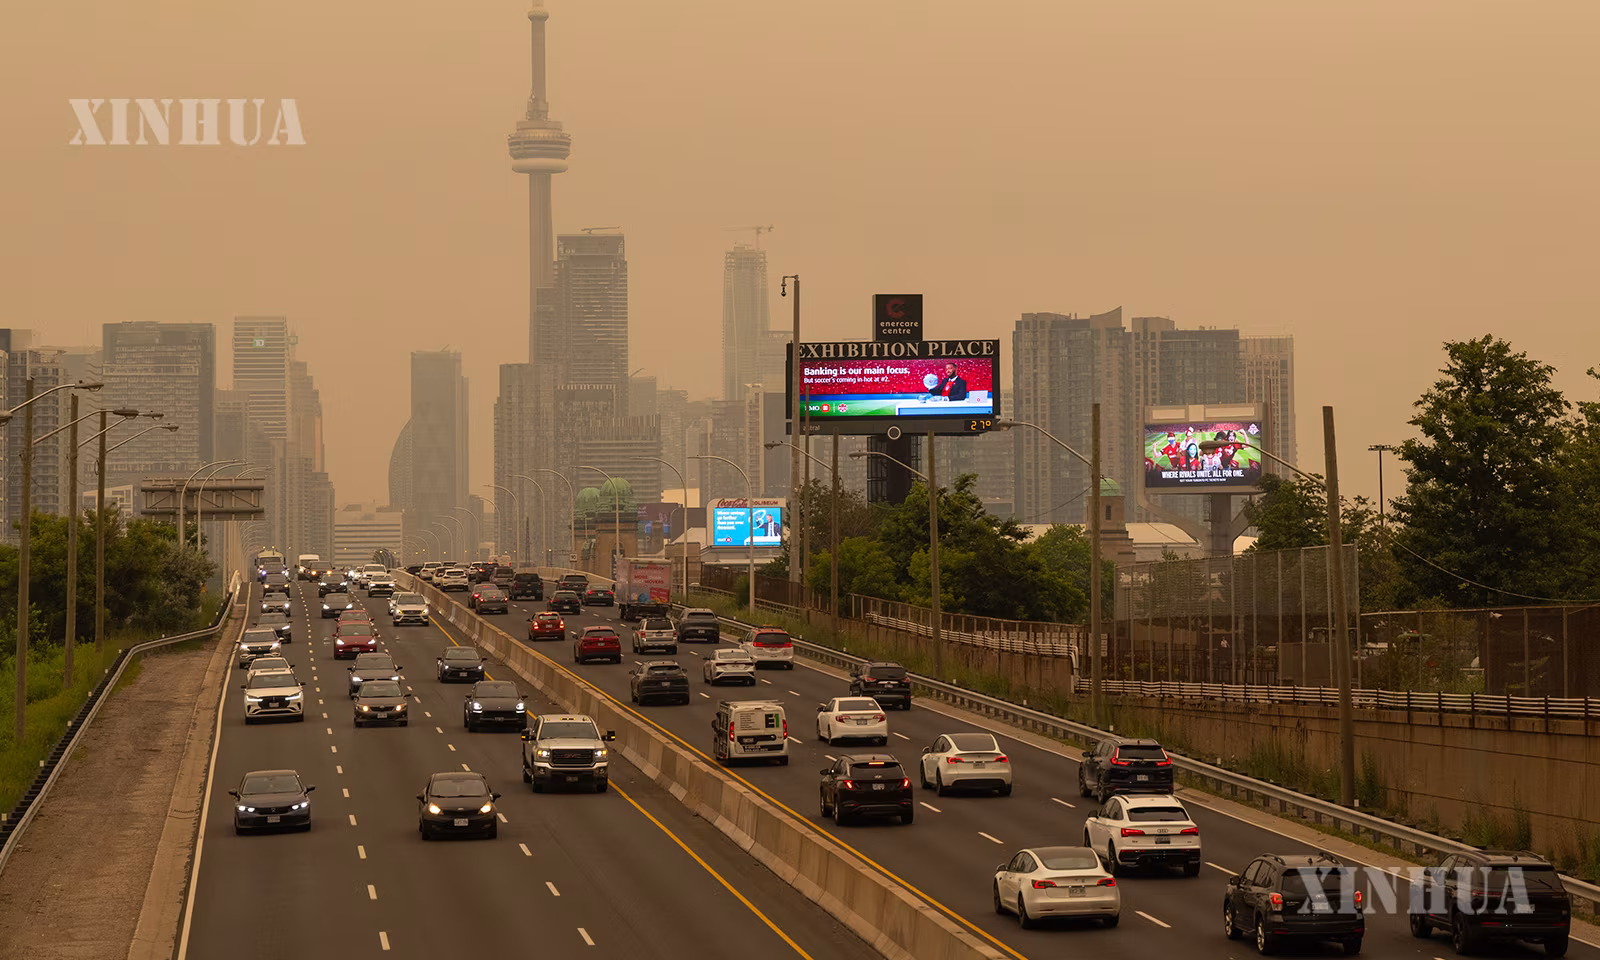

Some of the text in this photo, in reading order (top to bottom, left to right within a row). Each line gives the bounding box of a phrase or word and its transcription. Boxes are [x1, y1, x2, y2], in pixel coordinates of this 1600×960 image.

[799, 341, 994, 358] EXHIBITION PLACE
[804, 367, 838, 376] Banking
[840, 366, 846, 374] is
[864, 366, 885, 374] main
[886, 366, 910, 374] focus.
